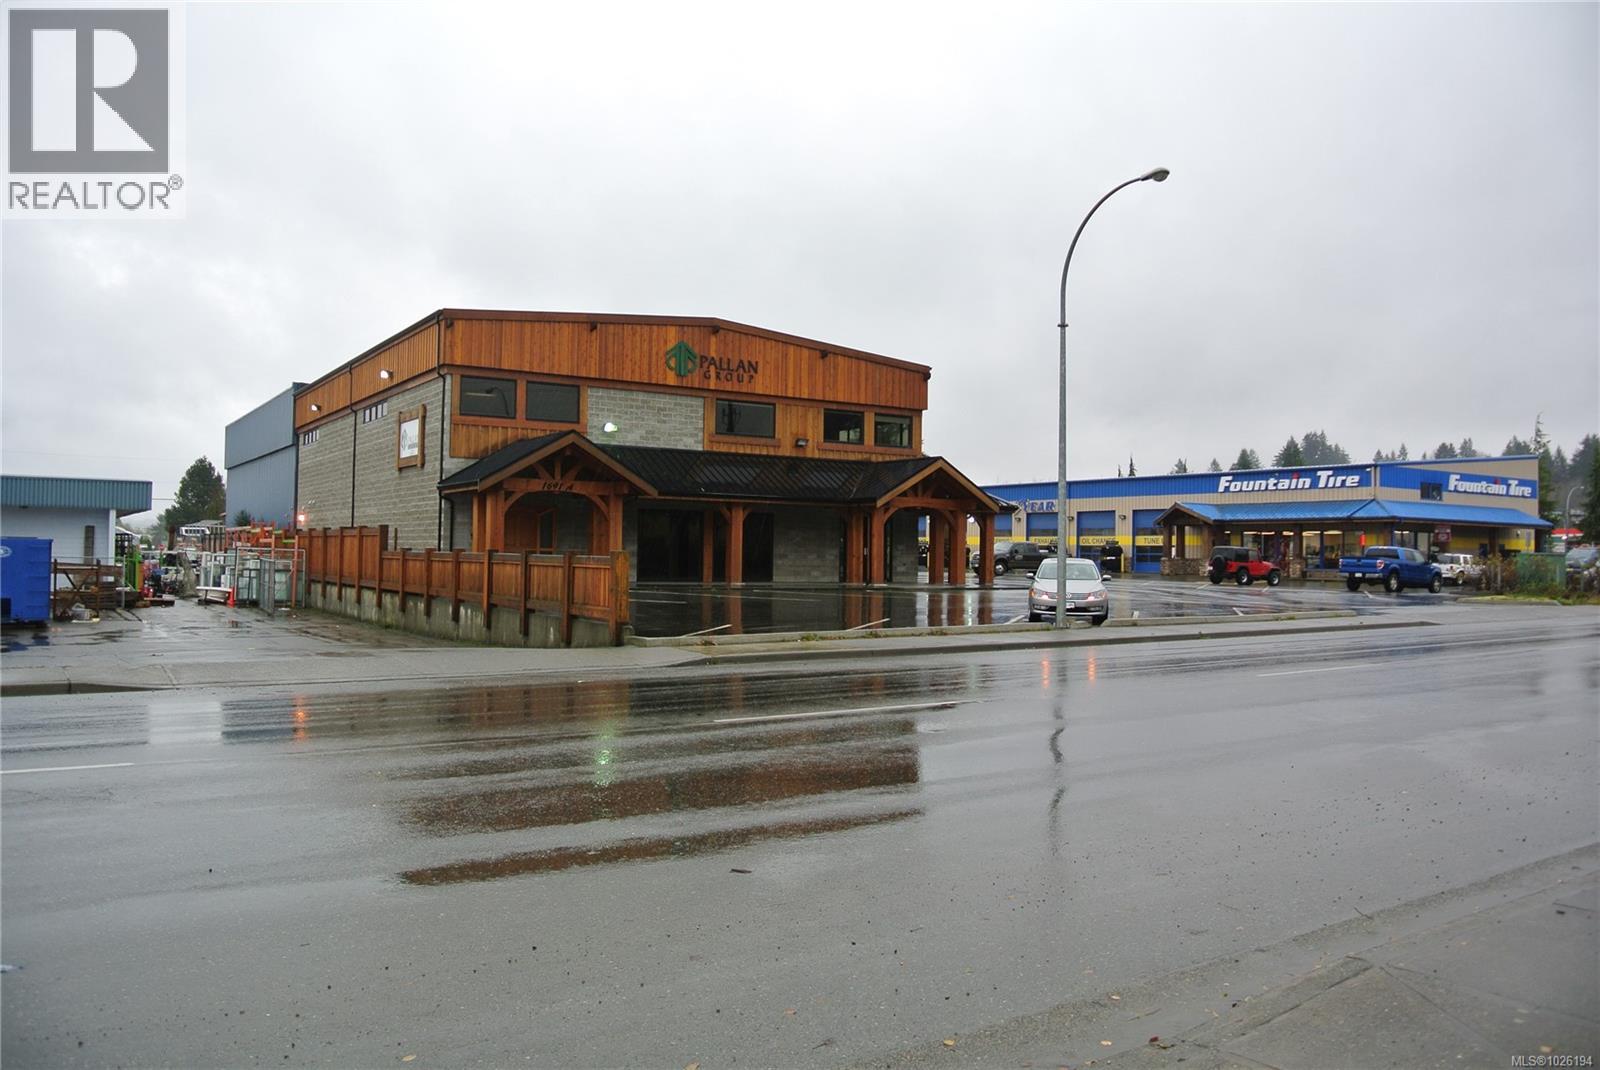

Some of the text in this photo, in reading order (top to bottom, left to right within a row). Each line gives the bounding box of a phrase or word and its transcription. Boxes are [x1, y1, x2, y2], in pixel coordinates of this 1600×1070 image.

[699, 354, 758, 374] PALLAN
[703, 370, 754, 384] GROUP
[1218, 470, 1361, 493] Fountain Tire
[1448, 474, 1532, 497] Fountain Tire
[1081, 537, 1091, 545] OIL
[1143, 537, 1160, 545] TUNE
